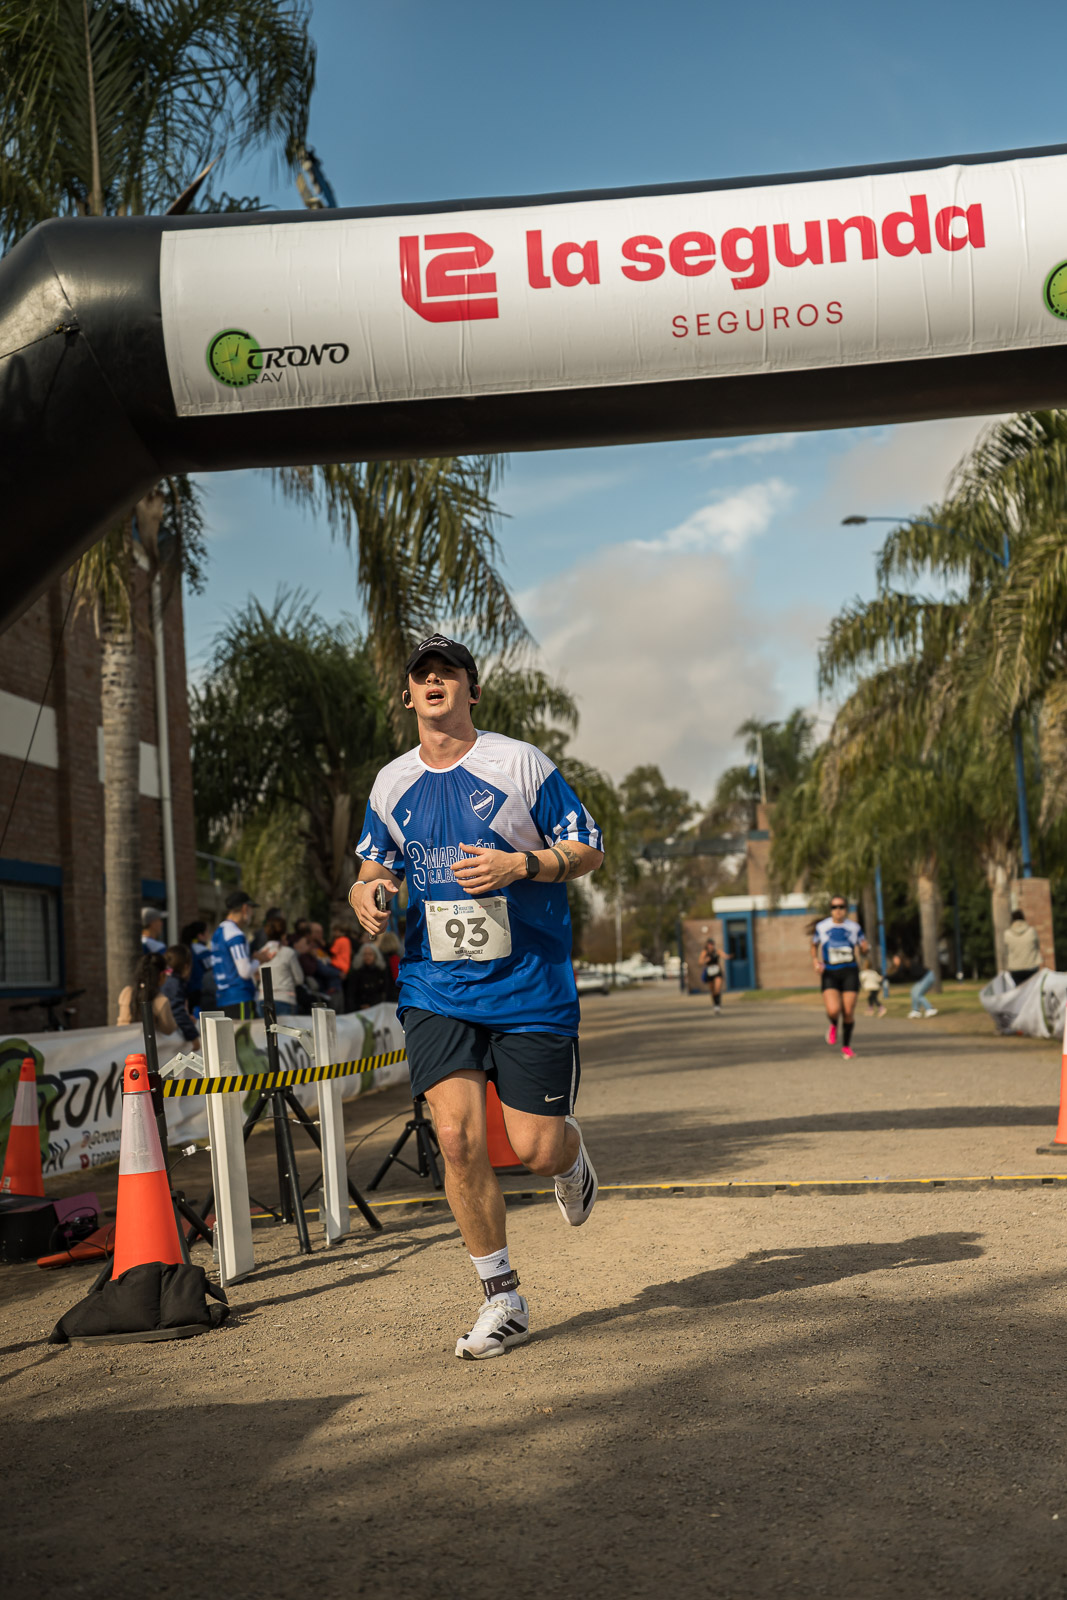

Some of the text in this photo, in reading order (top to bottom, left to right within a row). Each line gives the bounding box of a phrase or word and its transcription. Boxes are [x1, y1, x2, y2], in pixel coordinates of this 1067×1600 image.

[526, 194, 986, 291] la segunda
[671, 301, 844, 338] SEGUROS
[247, 343, 349, 370] CRONO
[247, 372, 283, 385] RAV
[406, 840, 427, 892] 3
[445, 917, 490, 948] 93
